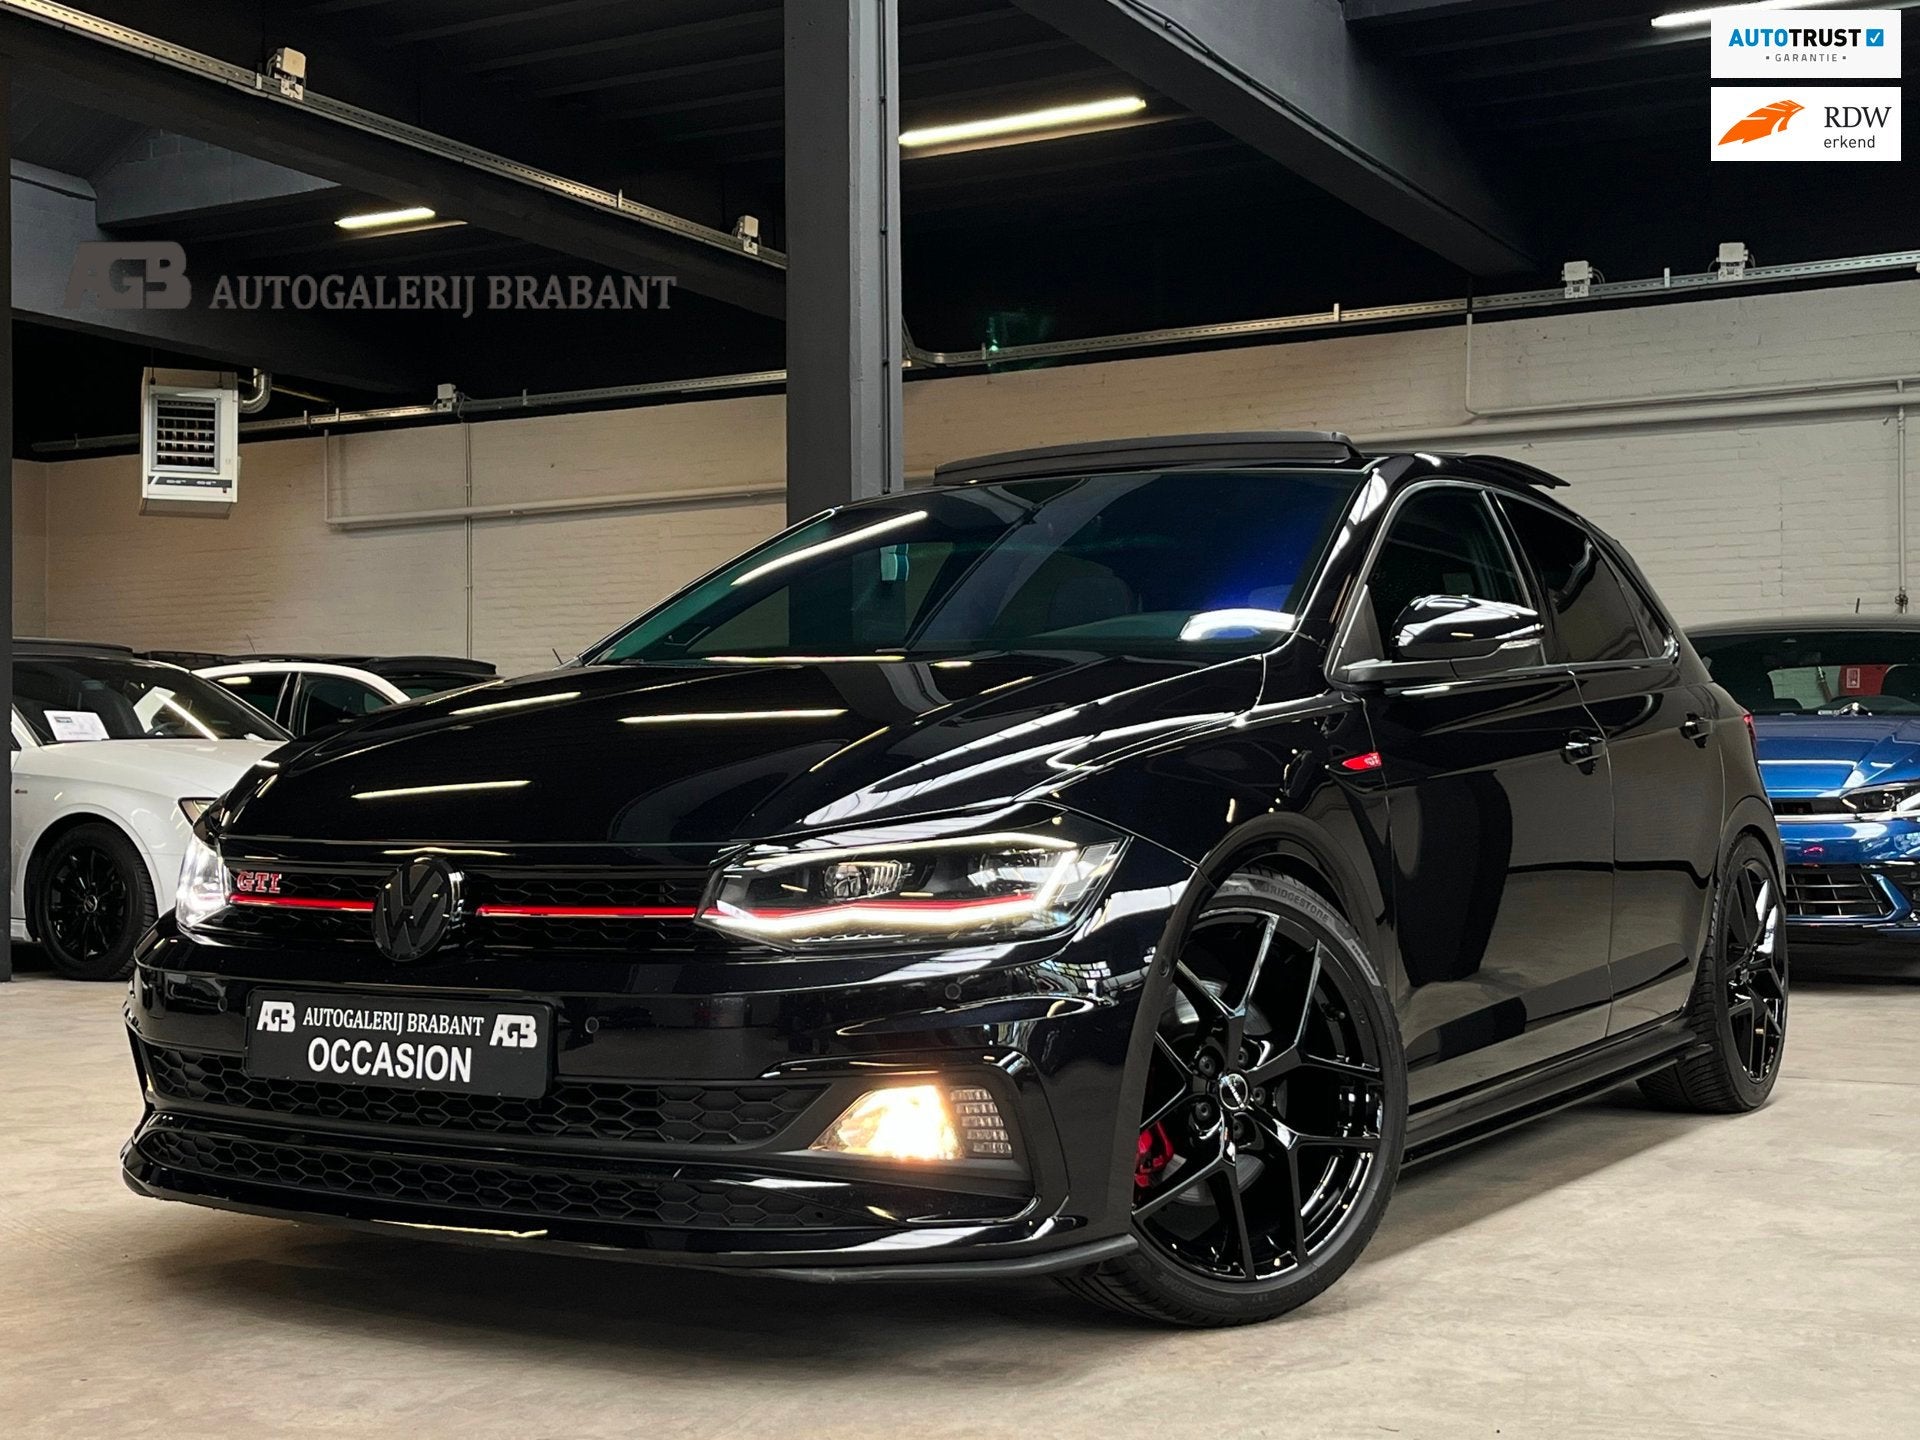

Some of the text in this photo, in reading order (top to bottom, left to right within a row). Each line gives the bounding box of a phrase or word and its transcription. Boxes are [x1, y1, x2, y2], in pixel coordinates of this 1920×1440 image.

[236, 871, 282, 894] GTI
[256, 1001, 538, 1048] AGB AUTOGALERIJ BRABANT AGB
[307, 1037, 472, 1083] OCCASION
